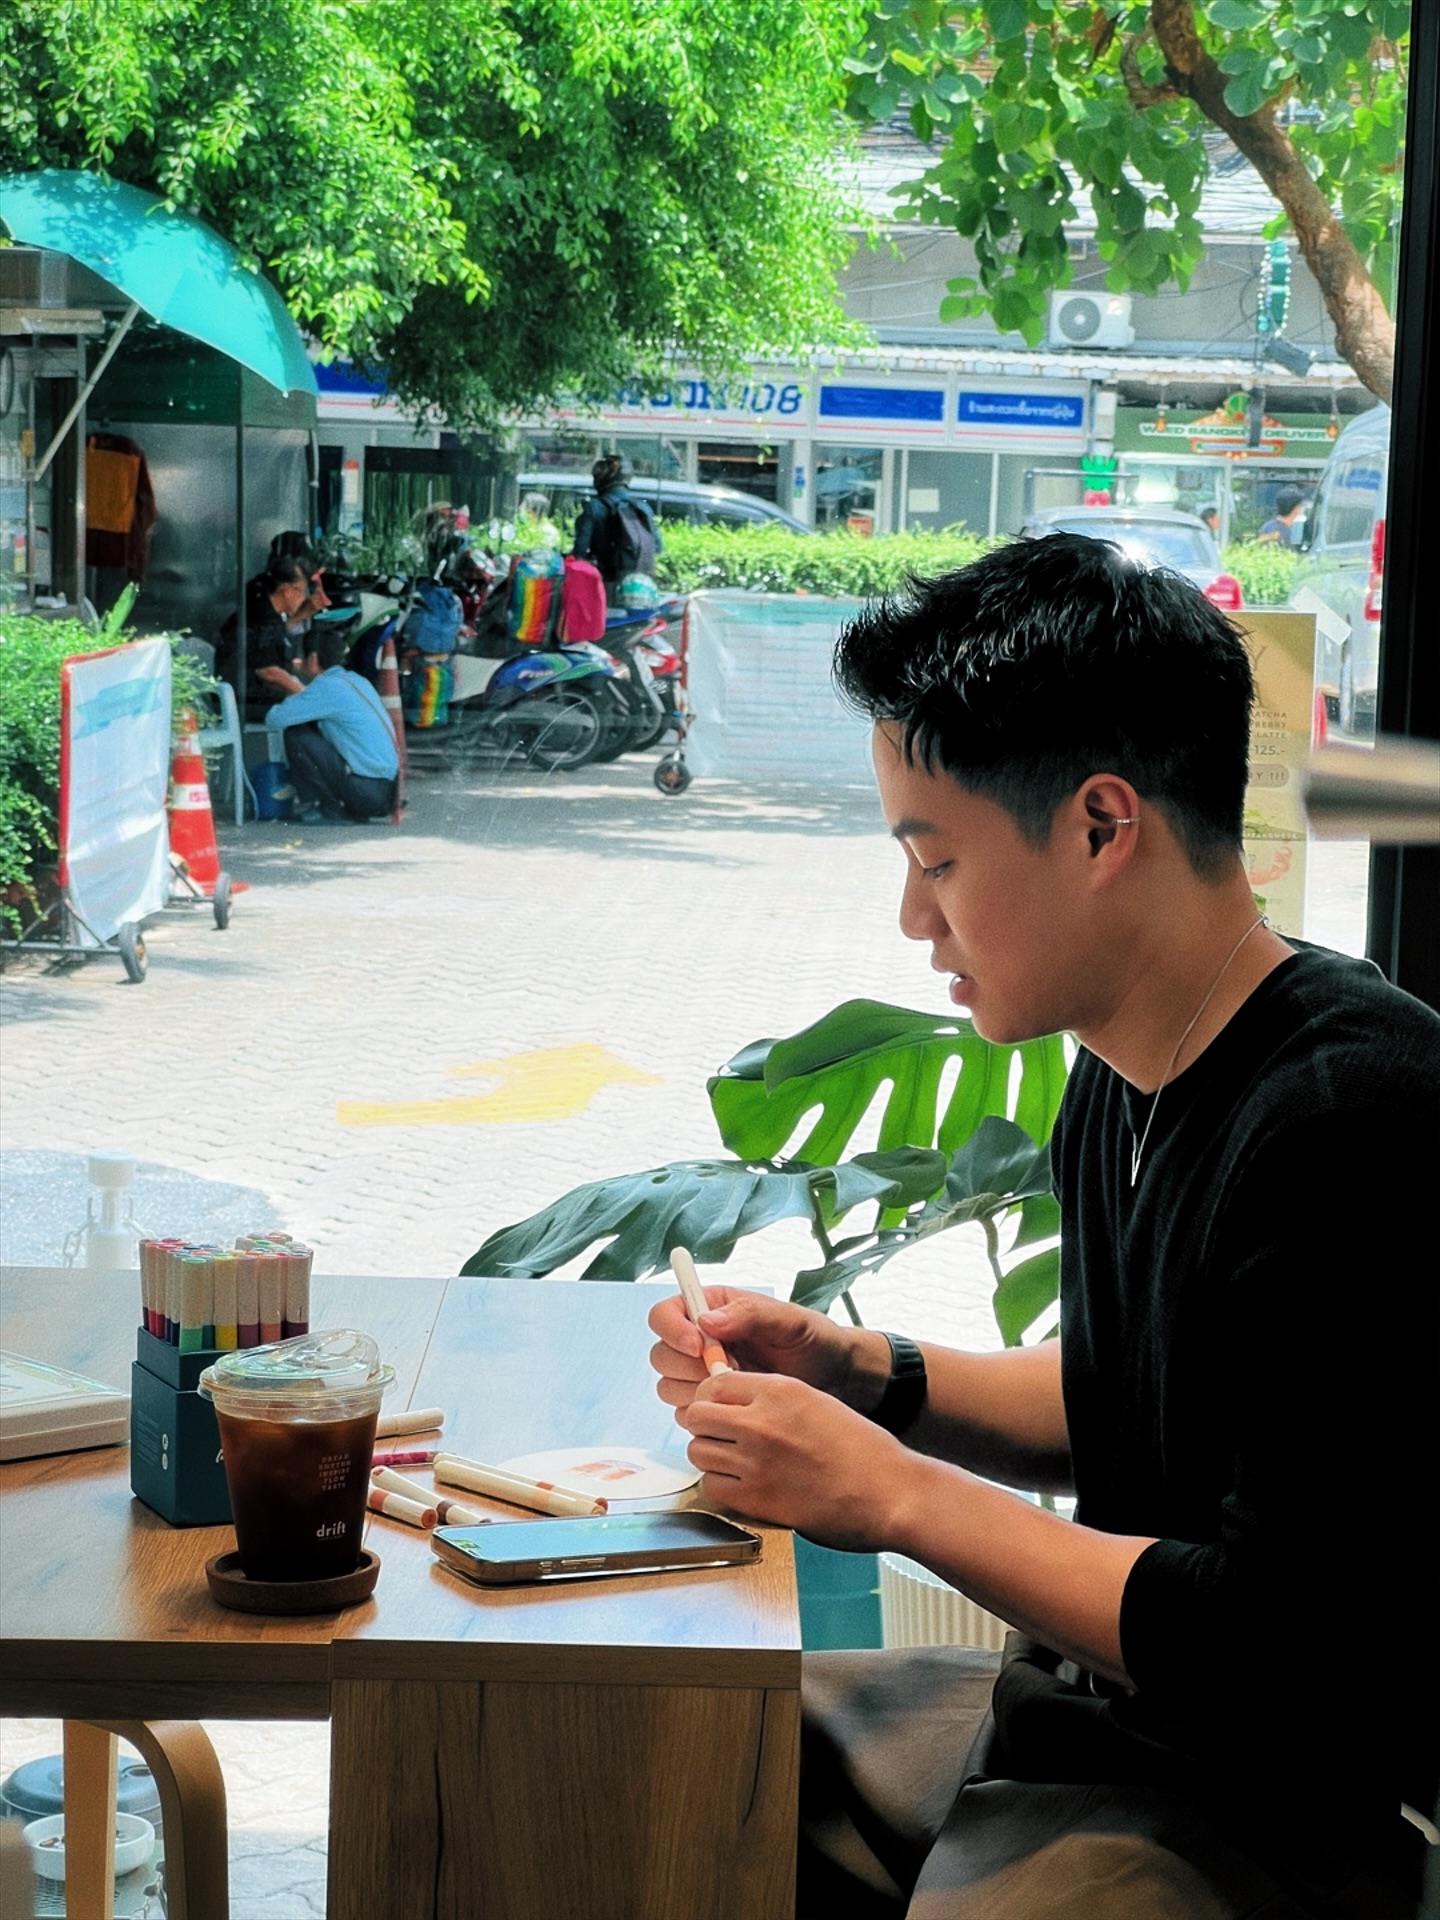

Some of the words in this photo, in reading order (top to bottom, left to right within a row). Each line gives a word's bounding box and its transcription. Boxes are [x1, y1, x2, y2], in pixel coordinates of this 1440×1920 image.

[740, 384, 803, 413] 108
[1142, 425, 1185, 434] WED
[1264, 430, 1332, 439] DELIVER
[322, 1482, 346, 1491] TASTE
[316, 1520, 346, 1537] drift
